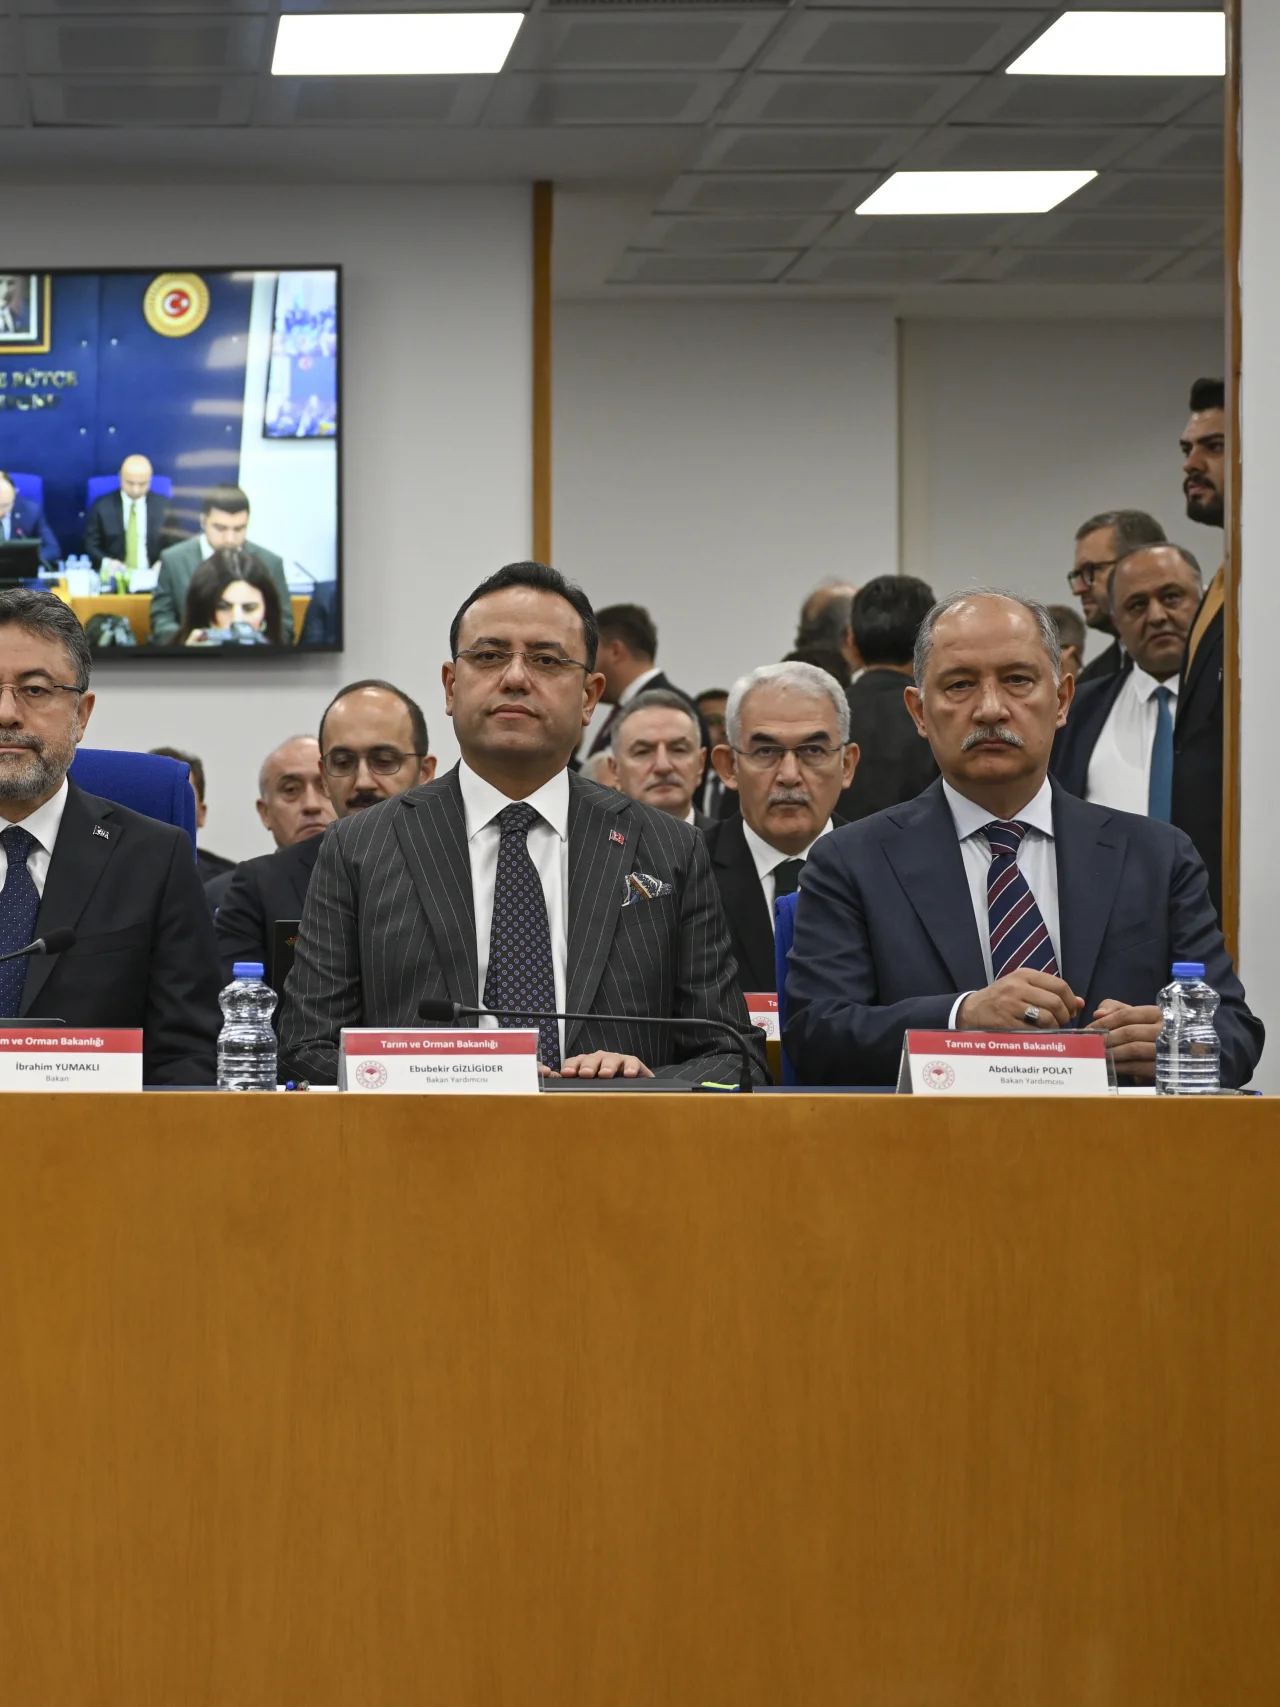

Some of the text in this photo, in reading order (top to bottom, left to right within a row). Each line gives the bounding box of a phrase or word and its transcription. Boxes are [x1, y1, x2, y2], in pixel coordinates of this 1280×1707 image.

[25, 1037, 59, 1046] Orman
[60, 1037, 104, 1047] Bakanlığı
[381, 1040, 408, 1049] Tarım
[422, 1040, 455, 1049] Orman
[456, 1040, 498, 1050] Bakanlığı
[945, 1040, 973, 1049] Tarım
[988, 1041, 1021, 1050] Orman
[1023, 1042, 1066, 1052] Bakanlığı
[16, 1062, 100, 1072] İbrahim YUMAKLI
[410, 1064, 504, 1073] Ebubekir GİZLİGİDER
[989, 1065, 1074, 1075] Abdulkadir POLAT
[1026, 1077, 1065, 1085] Yardımcısı
